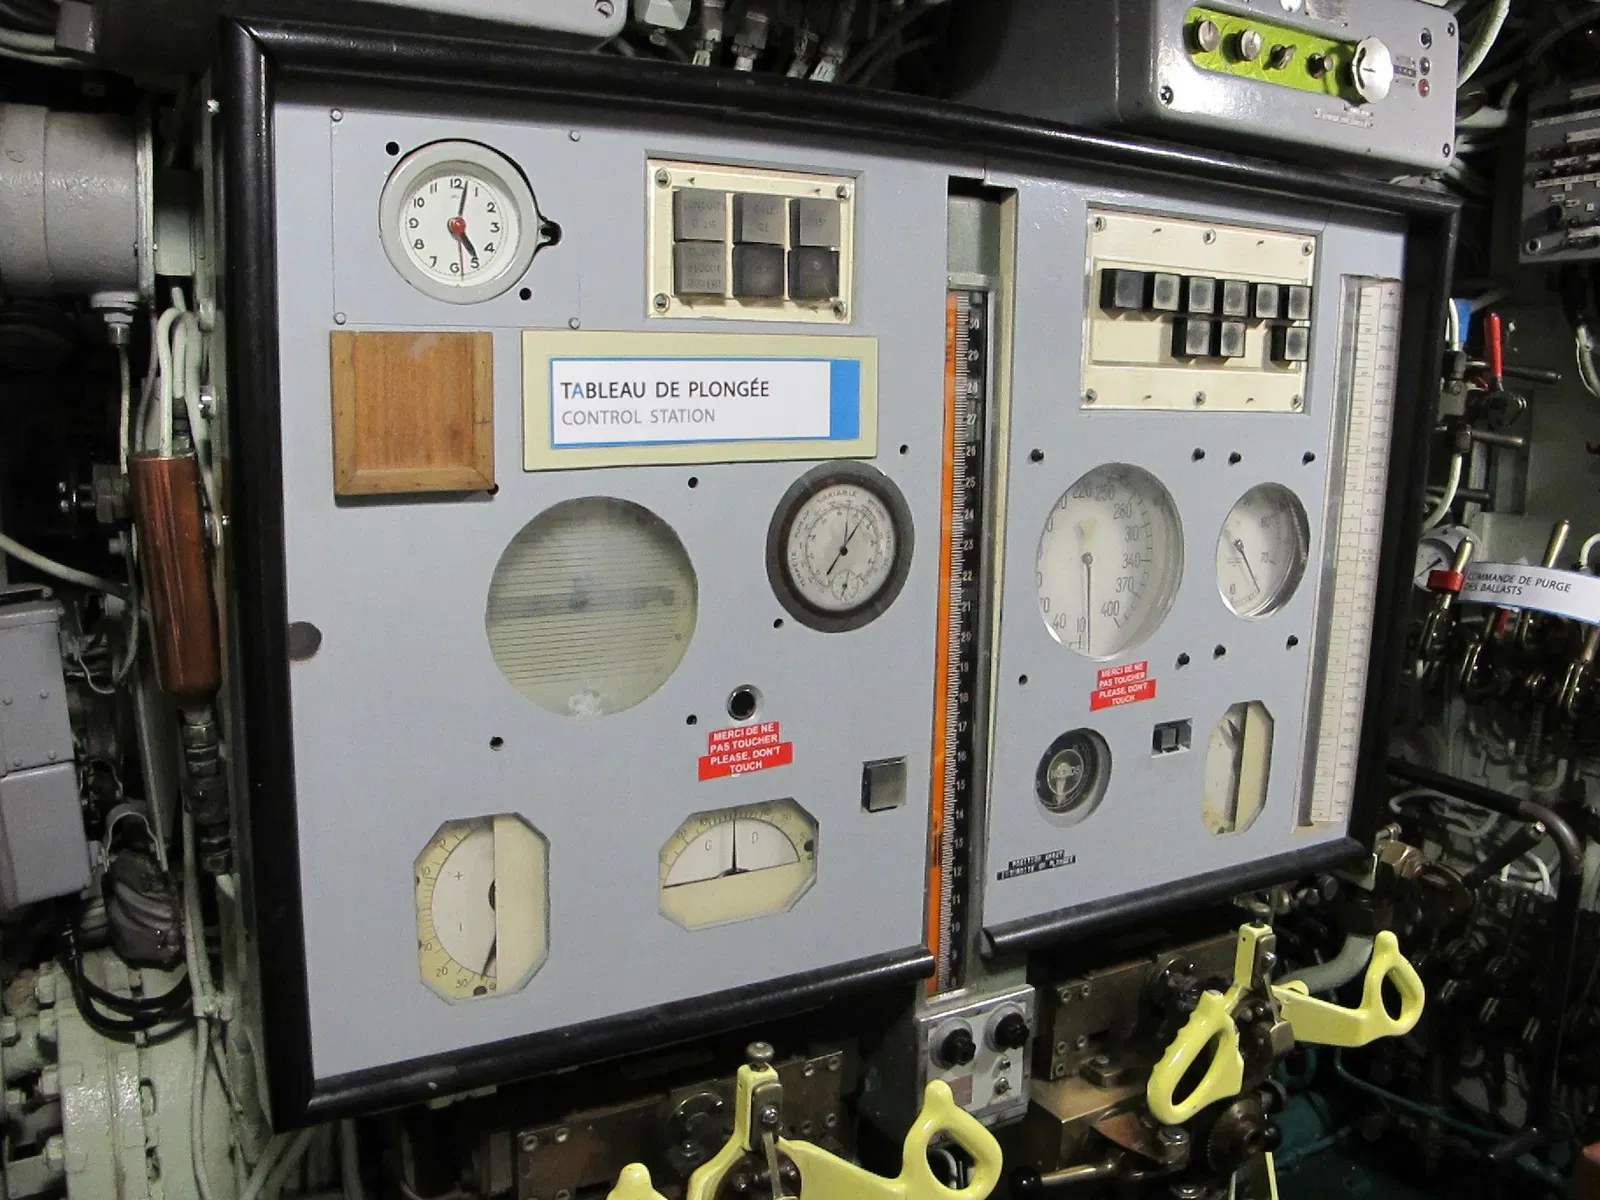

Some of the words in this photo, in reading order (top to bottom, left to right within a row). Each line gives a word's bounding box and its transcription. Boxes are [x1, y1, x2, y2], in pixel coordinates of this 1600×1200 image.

[429, 182, 438, 194] 11
[450, 178, 464, 189] 12
[474, 187, 478, 197] 1
[413, 197, 425, 208] 10
[487, 202, 496, 213] 2
[409, 217, 419, 228] 9
[490, 222, 500, 233] 3
[414, 239, 424, 250] 8
[484, 243, 495, 253] 4
[430, 256, 438, 268] 7
[471, 257, 480, 269] 5
[450, 263, 460, 274] 6
[561, 381, 646, 399] TABLEAU
[656, 381, 680, 398] DE
[688, 378, 770, 398] PLONGÉE
[562, 410, 643, 426] CONTROL
[650, 409, 716, 424] STATION
[967, 414, 977, 425] 27
[965, 477, 976, 488] 25
[964, 509, 975, 520] 24
[1122, 553, 1140, 568] 340
[963, 571, 973, 581] 22
[1116, 577, 1134, 593] 370
[1468, 572, 1515, 583] COMMANDE
[1519, 576, 1533, 585] DE
[1535, 579, 1572, 593] PURGE
[1480, 583, 1523, 595] BALLASTS
[962, 602, 971, 612] 21
[1101, 600, 1120, 616] 400
[1053, 613, 1067, 629] 40
[1077, 617, 1086, 633] 10
[961, 632, 972, 643] 20
[1101, 668, 1123, 677] MERCI
[1124, 665, 1133, 673] DE
[1100, 679, 1112, 688] PAS
[1114, 672, 1145, 685] TOUCHER
[1112, 695, 1135, 705] TOUCH
[714, 729, 744, 741] MERCI
[746, 726, 759, 735] DE
[761, 723, 774, 733] NE
[958, 721, 967, 732] 17
[710, 743, 731, 753] PAS
[733, 735, 778, 749] TOUCHER
[752, 746, 781, 758] DON'T
[730, 761, 762, 773] TOUCH
[704, 840, 713, 851] G
[436, 966, 448, 977] 20
